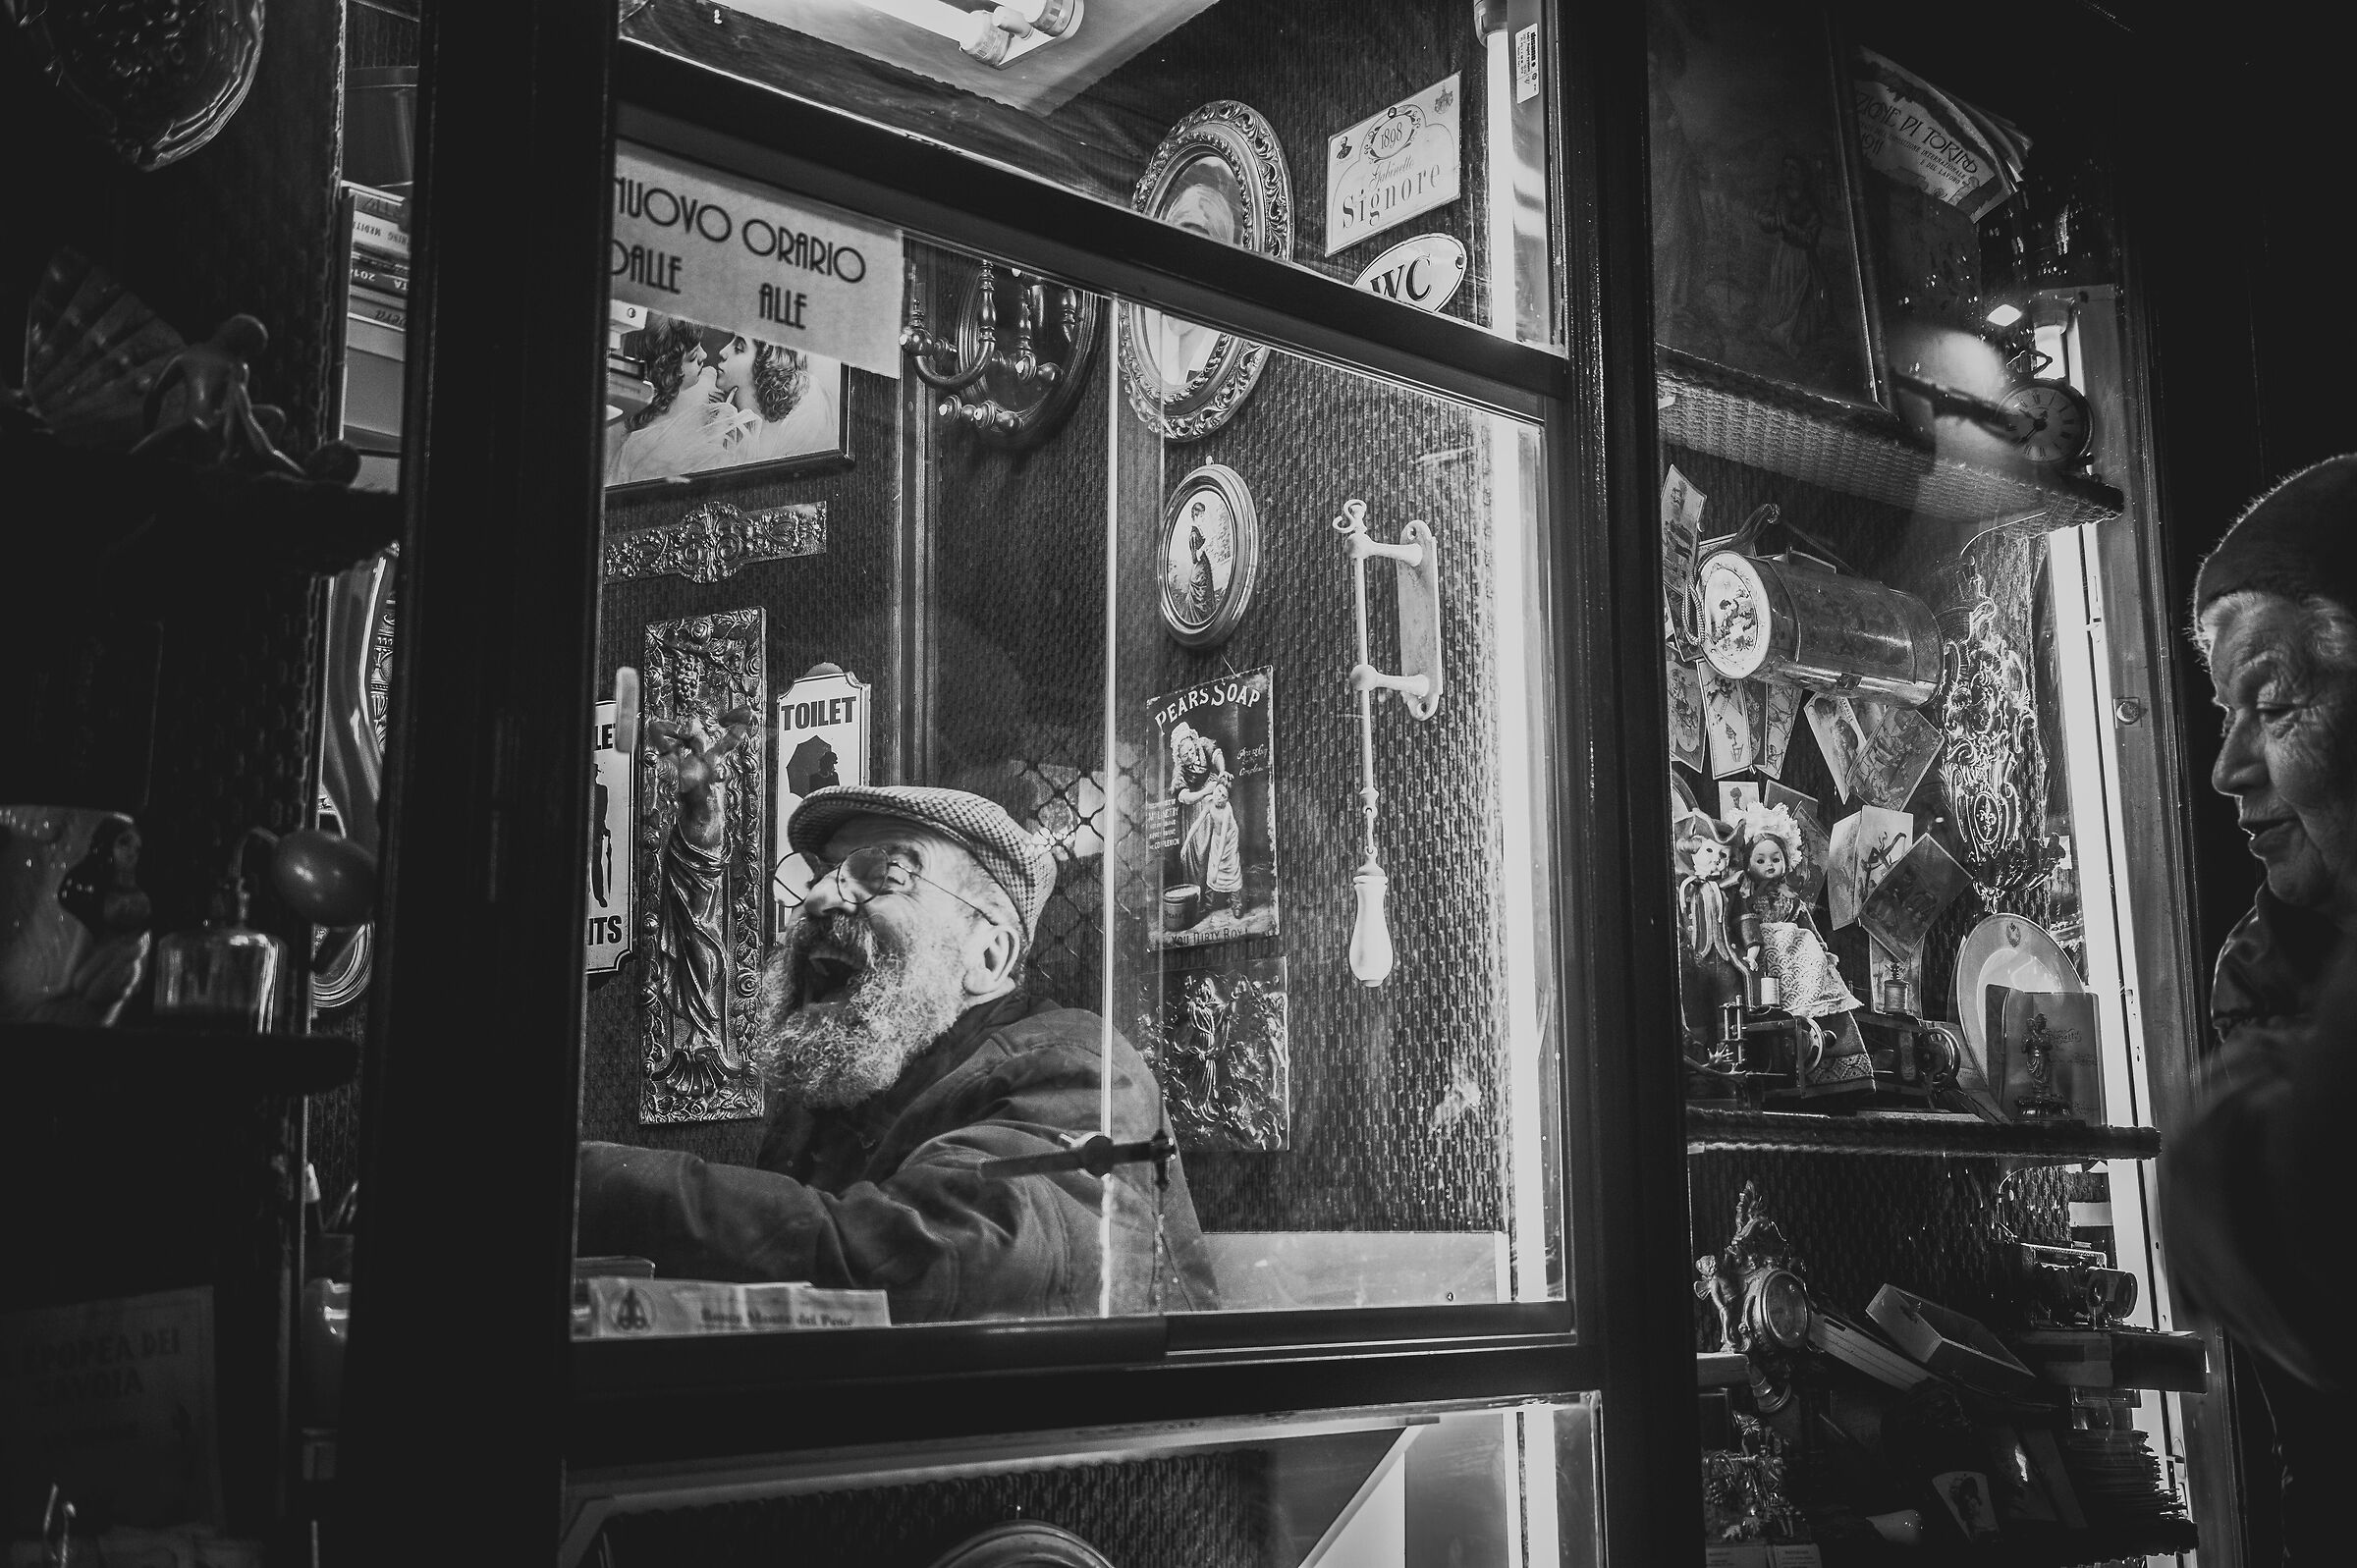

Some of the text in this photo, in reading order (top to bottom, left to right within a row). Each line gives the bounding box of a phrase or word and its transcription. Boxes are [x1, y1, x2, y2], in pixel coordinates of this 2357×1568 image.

[1380, 121, 1402, 150] 1898
[1861, 133, 1884, 154] 1911
[1899, 116, 1923, 136] DI
[1922, 128, 1977, 174] TORINO
[1921, 150, 1966, 180] INTERNAZIONALE
[1926, 162, 1938, 172] DEL
[1939, 169, 1960, 186] LAVORO
[1343, 163, 1441, 229] Signore
[613, 176, 866, 283] NUOVO ORARIO
[351, 268, 376, 282] 201
[611, 239, 807, 330] DALLE ALLE
[1369, 252, 1431, 301] WC
[781, 695, 856, 731] TOILET
[1154, 682, 1261, 736] PEARS SOAP
[1171, 935, 1189, 946] YOU
[1193, 931, 1220, 944] DIRTY
[140, 1326, 182, 1359] DEI
